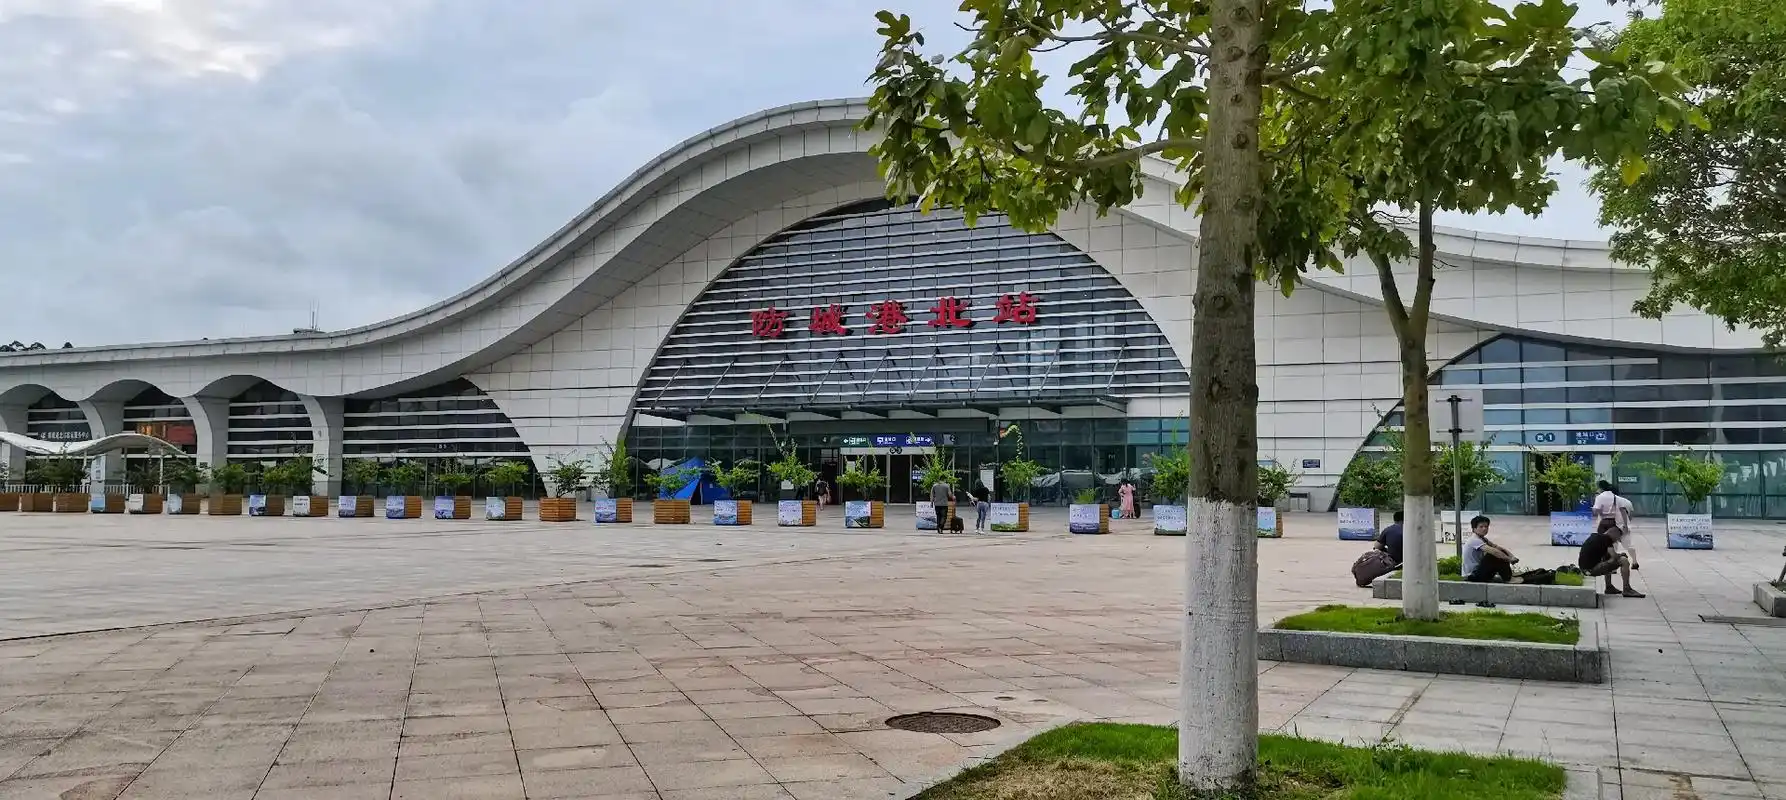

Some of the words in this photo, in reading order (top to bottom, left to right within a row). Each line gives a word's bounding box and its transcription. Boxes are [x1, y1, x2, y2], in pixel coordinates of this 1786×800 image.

[751, 292, 1038, 338] 防城港北站
